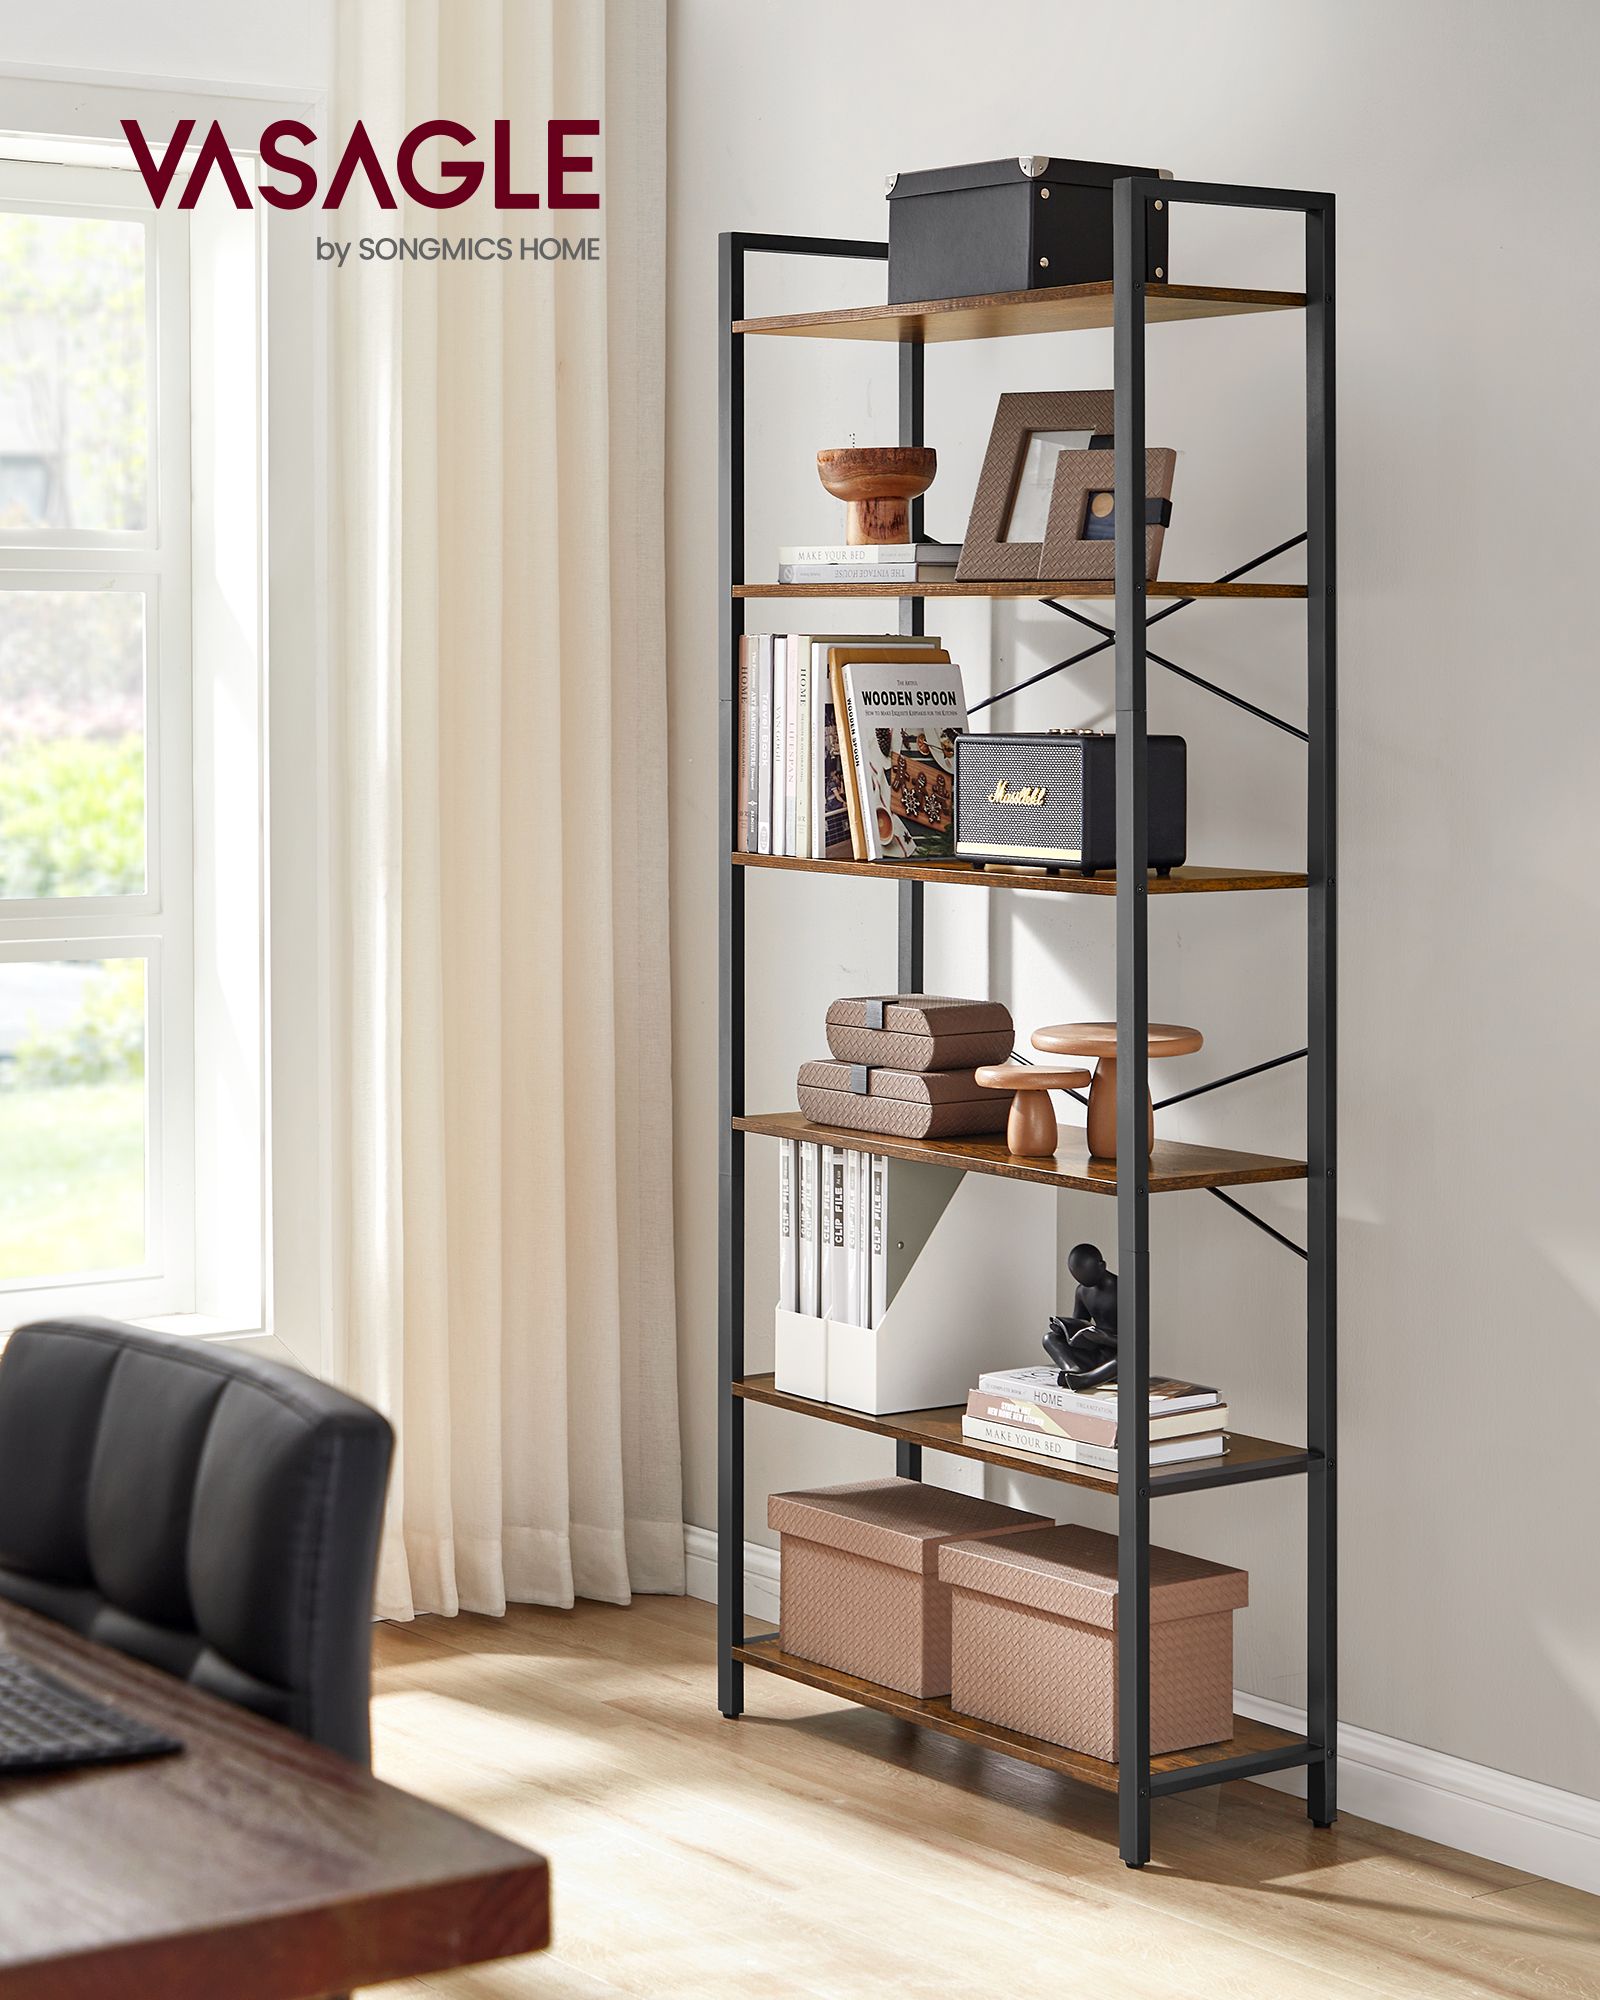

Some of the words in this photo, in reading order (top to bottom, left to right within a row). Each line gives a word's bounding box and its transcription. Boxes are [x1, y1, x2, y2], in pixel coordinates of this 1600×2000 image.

[798, 551, 822, 561] MAKE
[825, 550, 847, 560] YOUR
[850, 550, 866, 560] BED
[862, 691, 913, 706] WOODEN
[917, 691, 957, 706] SPOON
[847, 698, 855, 735] WOODEN
[988, 780, 1047, 806] Marshall
[834, 1187, 843, 1213] FILE
[835, 1218, 843, 1243] CLIP
[1034, 1391, 1063, 1407] HOME
[985, 1428, 1012, 1441] MAKE
[1015, 1434, 1041, 1448] YOUR
[1045, 1441, 1062, 1454] BED
